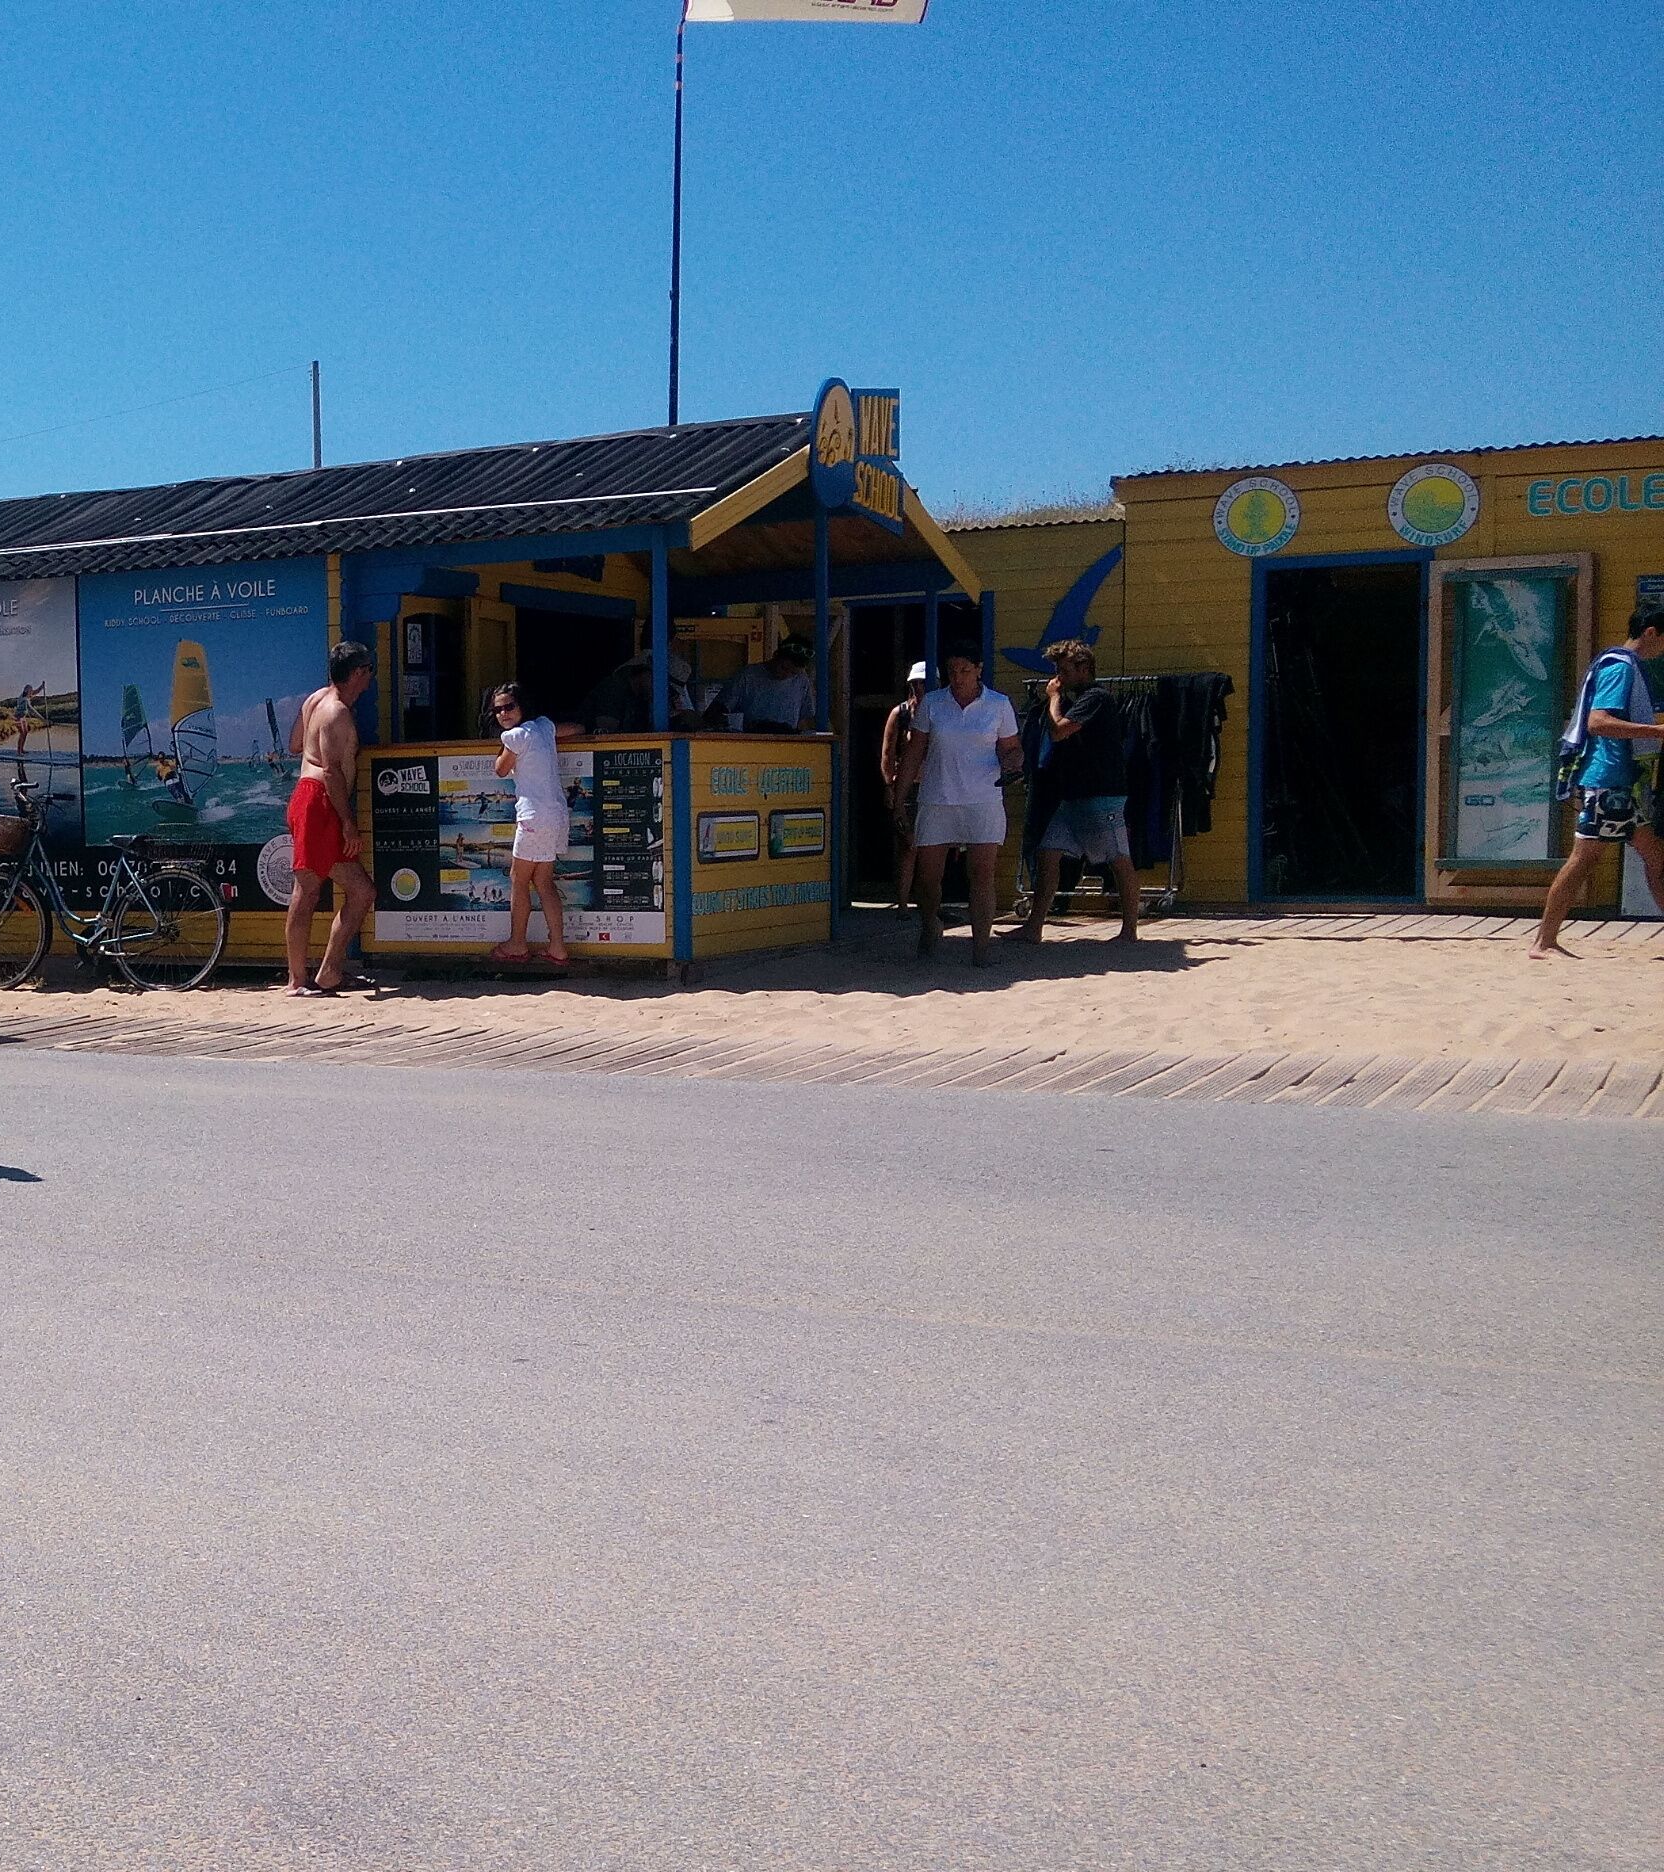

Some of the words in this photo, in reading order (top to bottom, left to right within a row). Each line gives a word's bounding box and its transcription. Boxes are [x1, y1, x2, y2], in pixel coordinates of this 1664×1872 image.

[859, 395, 898, 457] WAVE
[853, 461, 903, 522] SCHOOL
[1217, 485, 1242, 518] WAVE
[1249, 479, 1296, 514] SCHOOL
[1390, 471, 1418, 507] WAVE
[1425, 465, 1477, 500] SCHOOL
[1527, 472, 1664, 517] ECOLE
[1399, 520, 1467, 546] WINDSURF
[134, 584, 204, 606] PLANCHE
[210, 580, 221, 600] À
[227, 579, 277, 599] VOILE
[128, 613, 161, 626] SCHOOL
[614, 752, 651, 766] LOCATION
[400, 767, 424, 781] WAVE
[400, 782, 428, 792] SCHOOL
[97, 860, 118, 876] 06
[215, 859, 237, 876] 84
